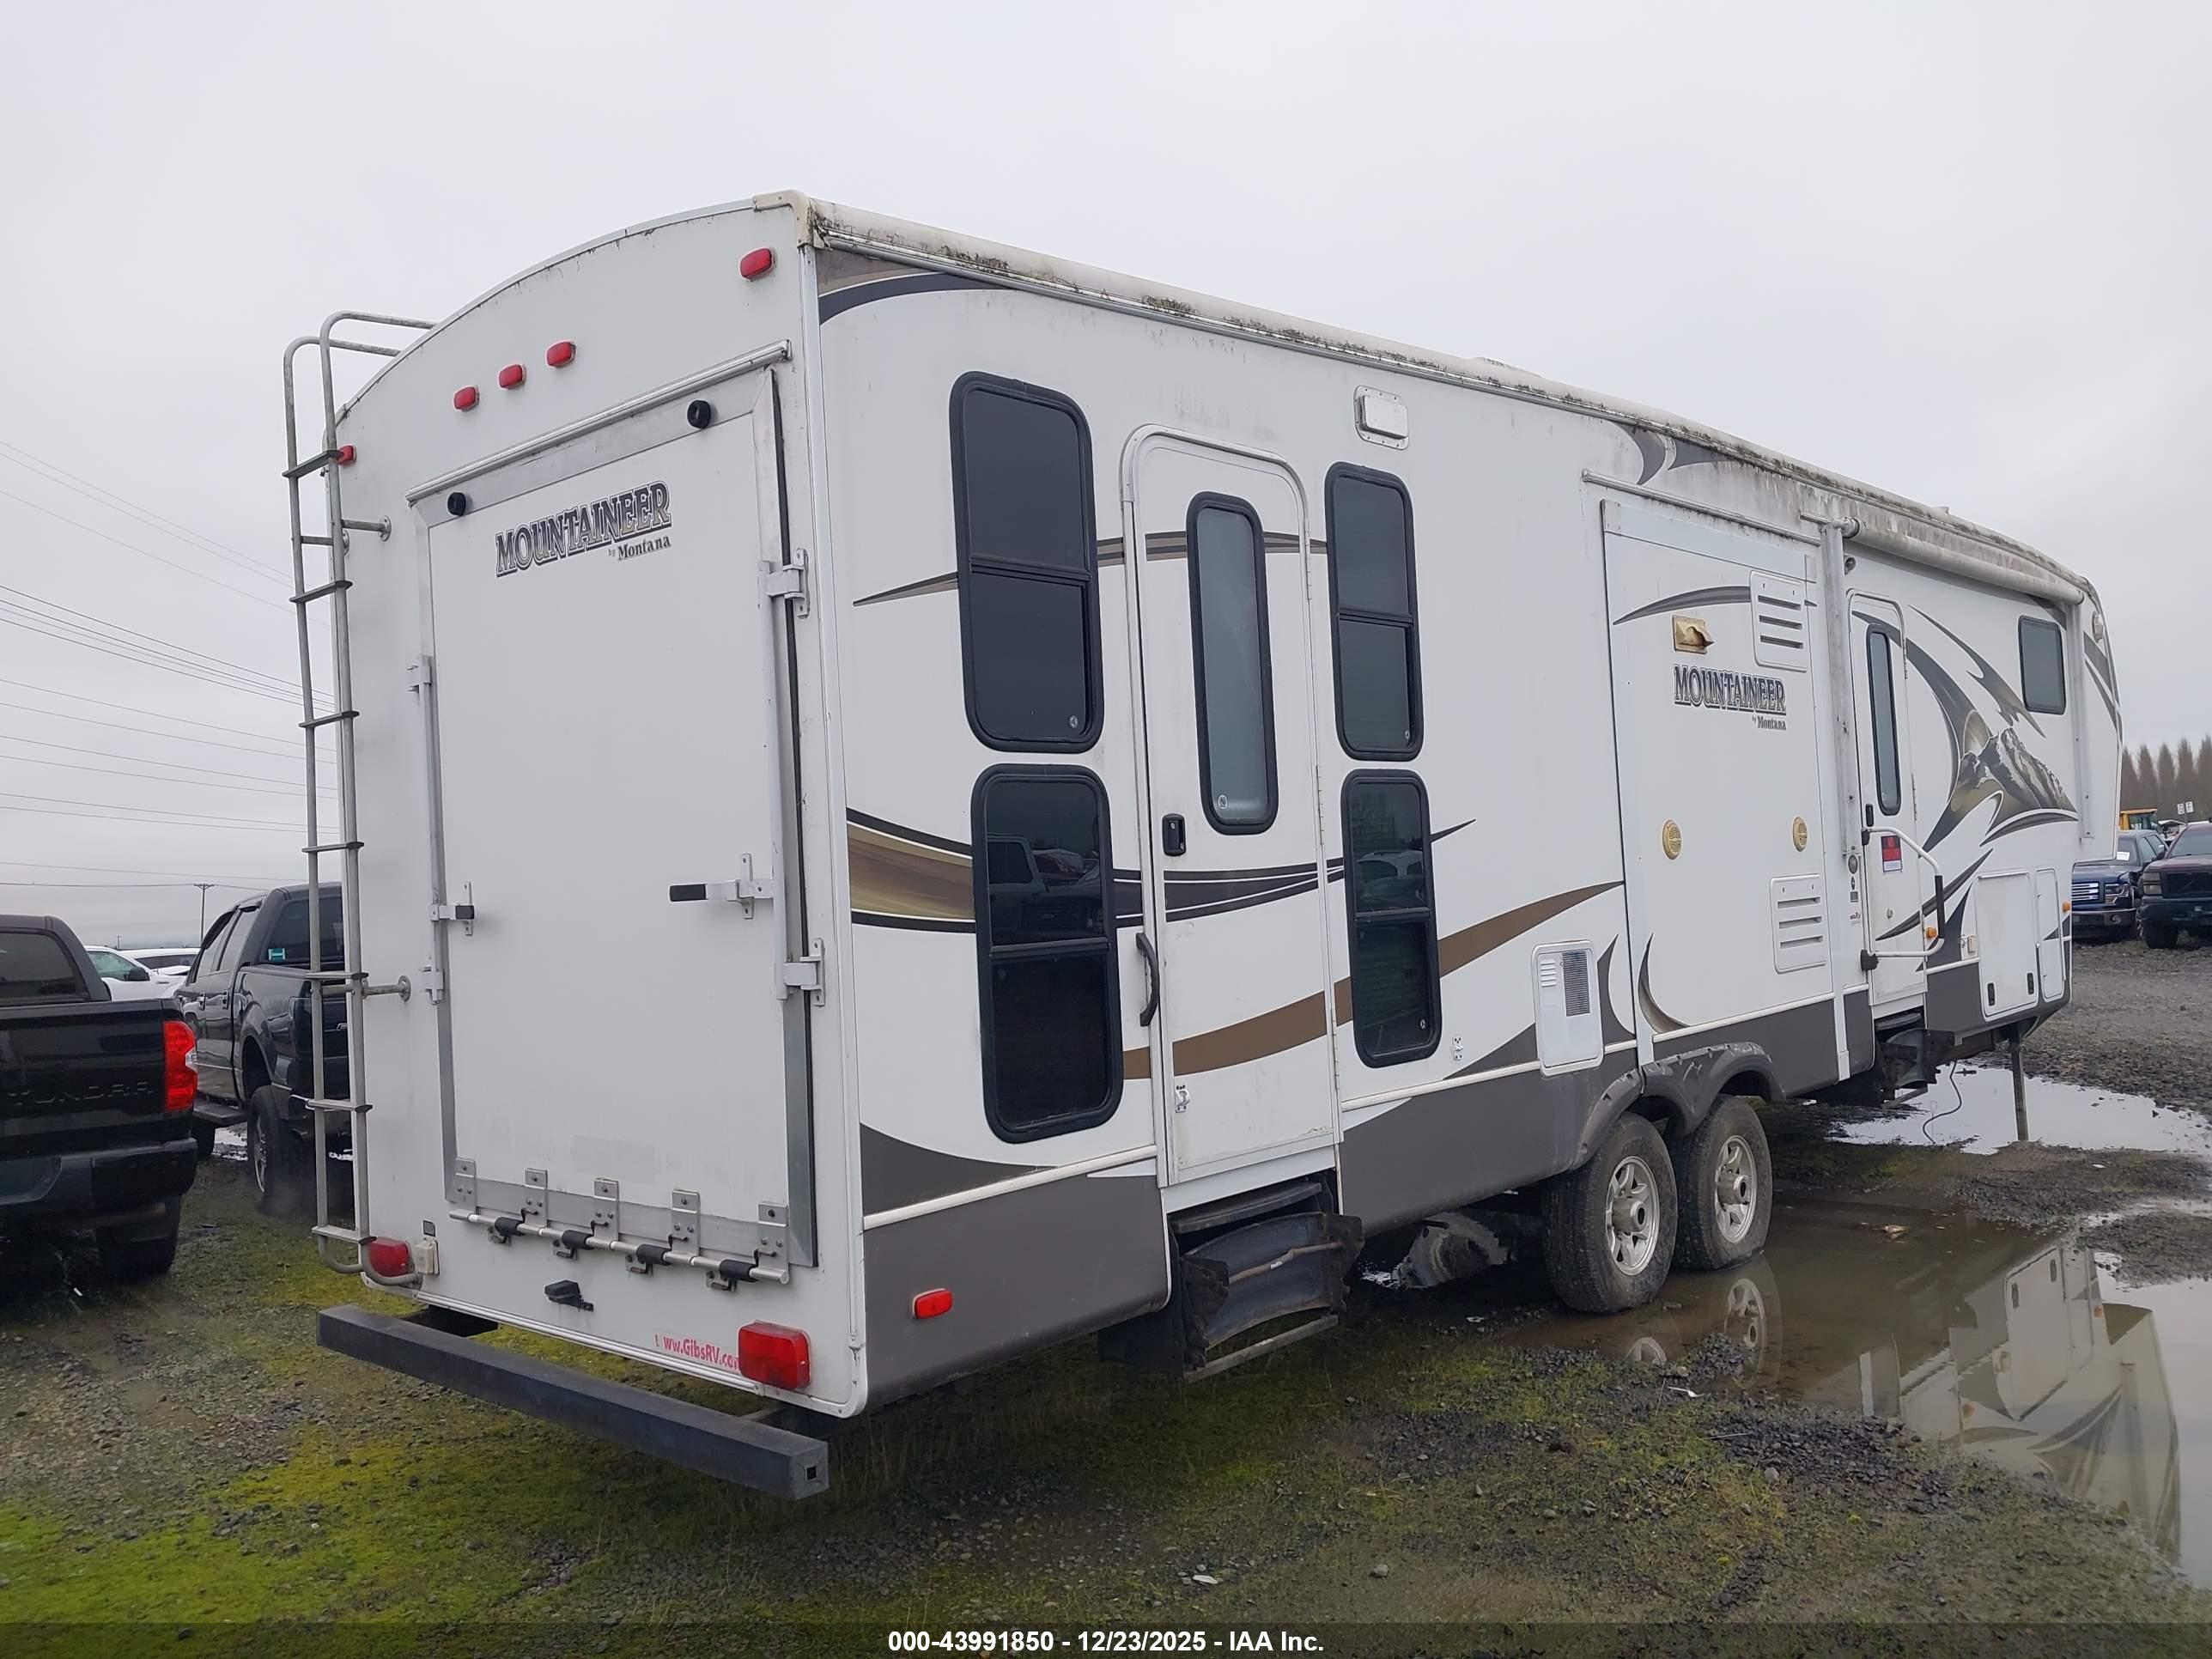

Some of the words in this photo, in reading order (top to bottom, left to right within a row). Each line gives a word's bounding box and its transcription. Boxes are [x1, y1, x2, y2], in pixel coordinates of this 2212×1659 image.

[495, 480, 672, 578] MOUNTAINEER
[608, 547, 616, 556] by
[617, 535, 672, 561] Montana
[1674, 664, 1787, 716] MOUNTAINEER
[1757, 716, 1787, 730] Montana
